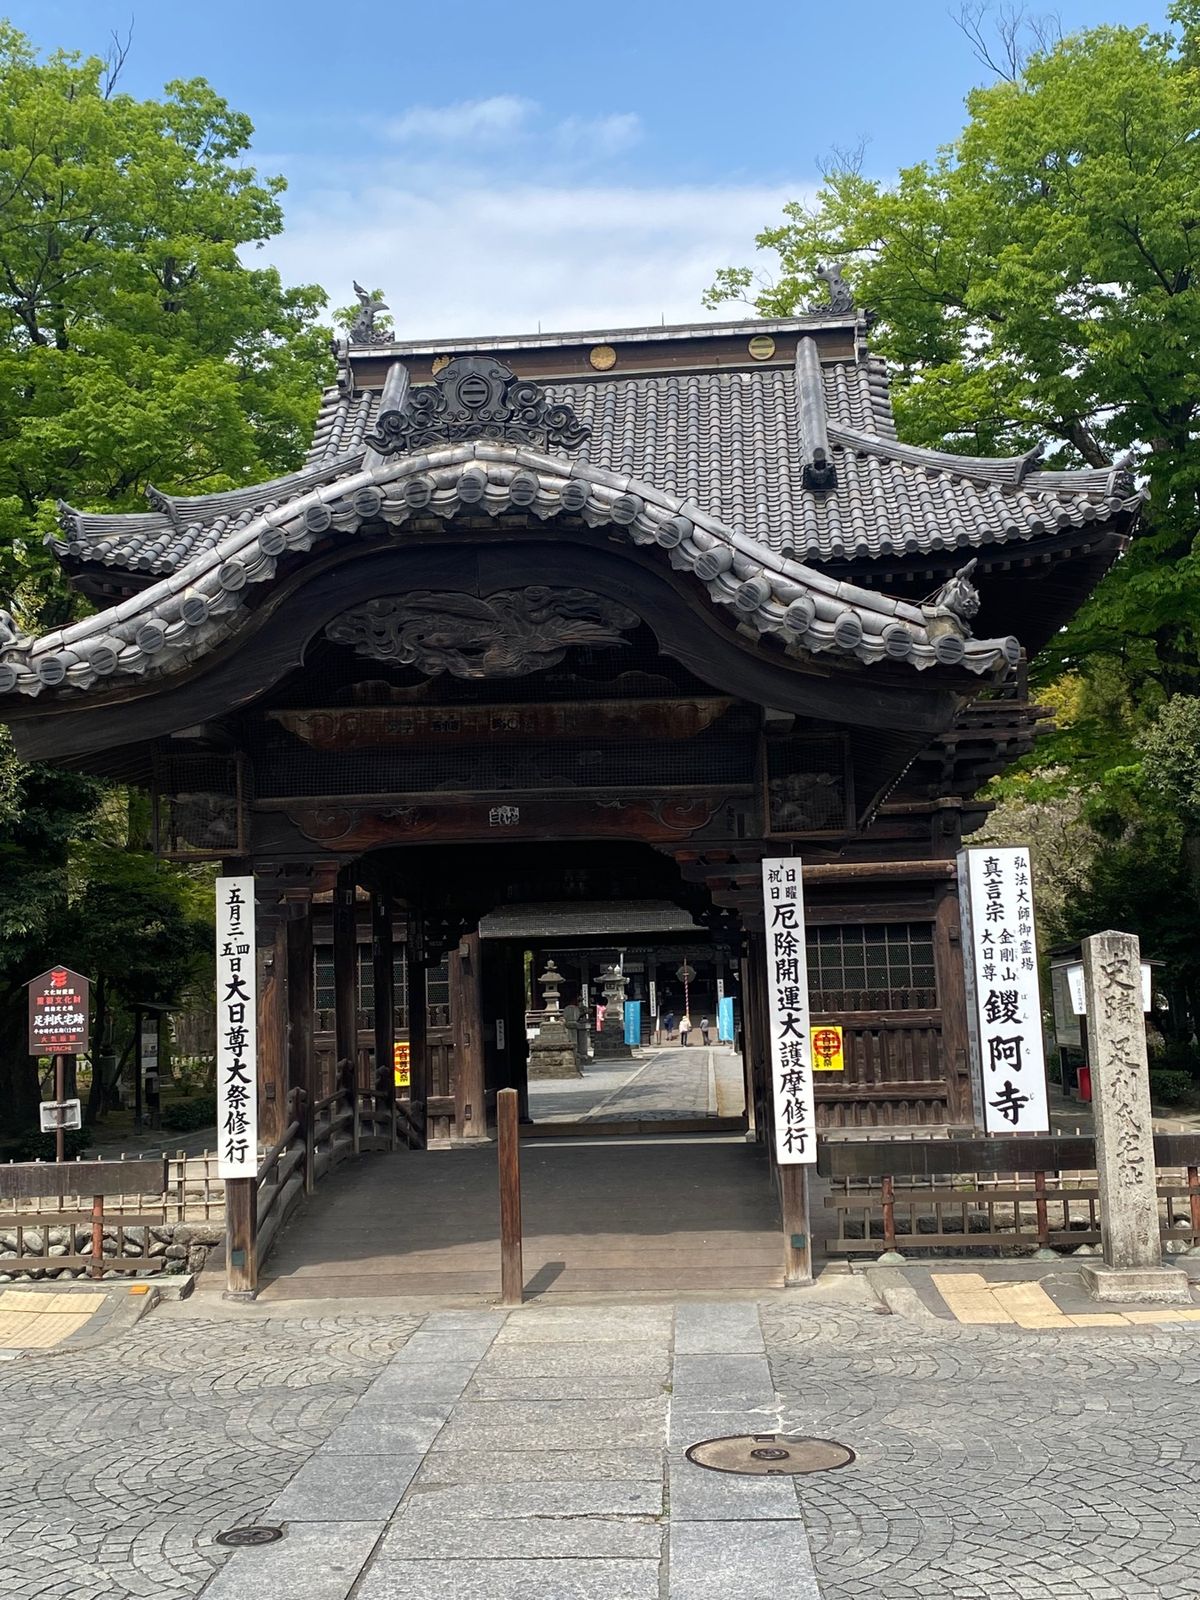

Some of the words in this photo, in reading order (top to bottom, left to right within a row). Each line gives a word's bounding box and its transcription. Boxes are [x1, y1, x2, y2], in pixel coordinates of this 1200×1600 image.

[768, 868, 782, 900] 祝日
[785, 868, 797, 900] 日曜
[982, 856, 1005, 923] 真言宗
[980, 928, 997, 982] 大日尊
[997, 928, 1016, 982] 金剛山
[34, 1013, 85, 1026] 足利氏宅跡
